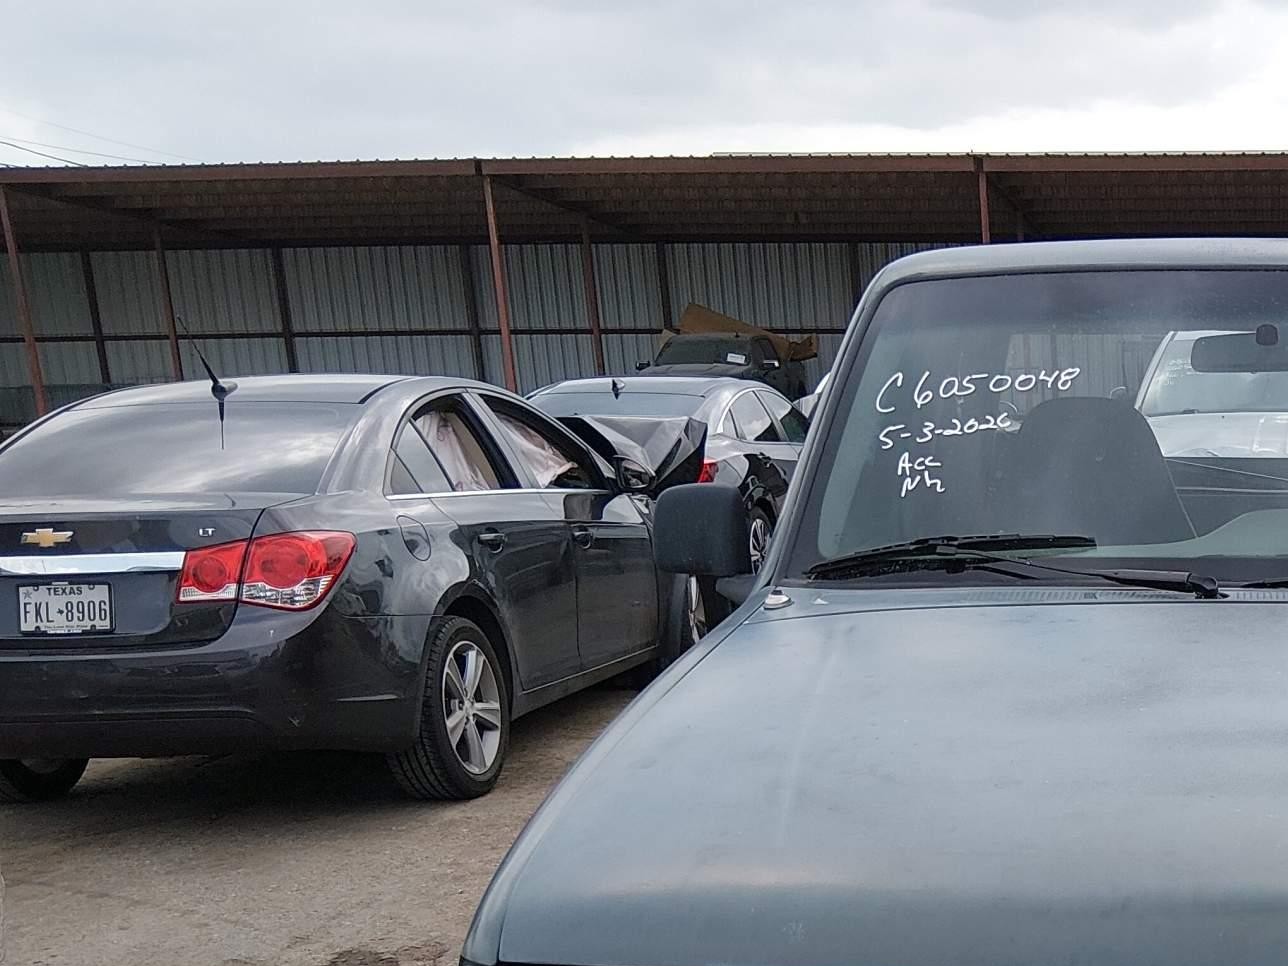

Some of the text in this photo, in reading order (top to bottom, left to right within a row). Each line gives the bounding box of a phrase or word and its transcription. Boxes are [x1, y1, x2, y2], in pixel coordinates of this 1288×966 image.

[878, 412, 1012, 449] 5-3-2026
[199, 527, 217, 537] LT
[46, 586, 83, 596] TEXAS
[23, 600, 108, 623] FKL 8906
